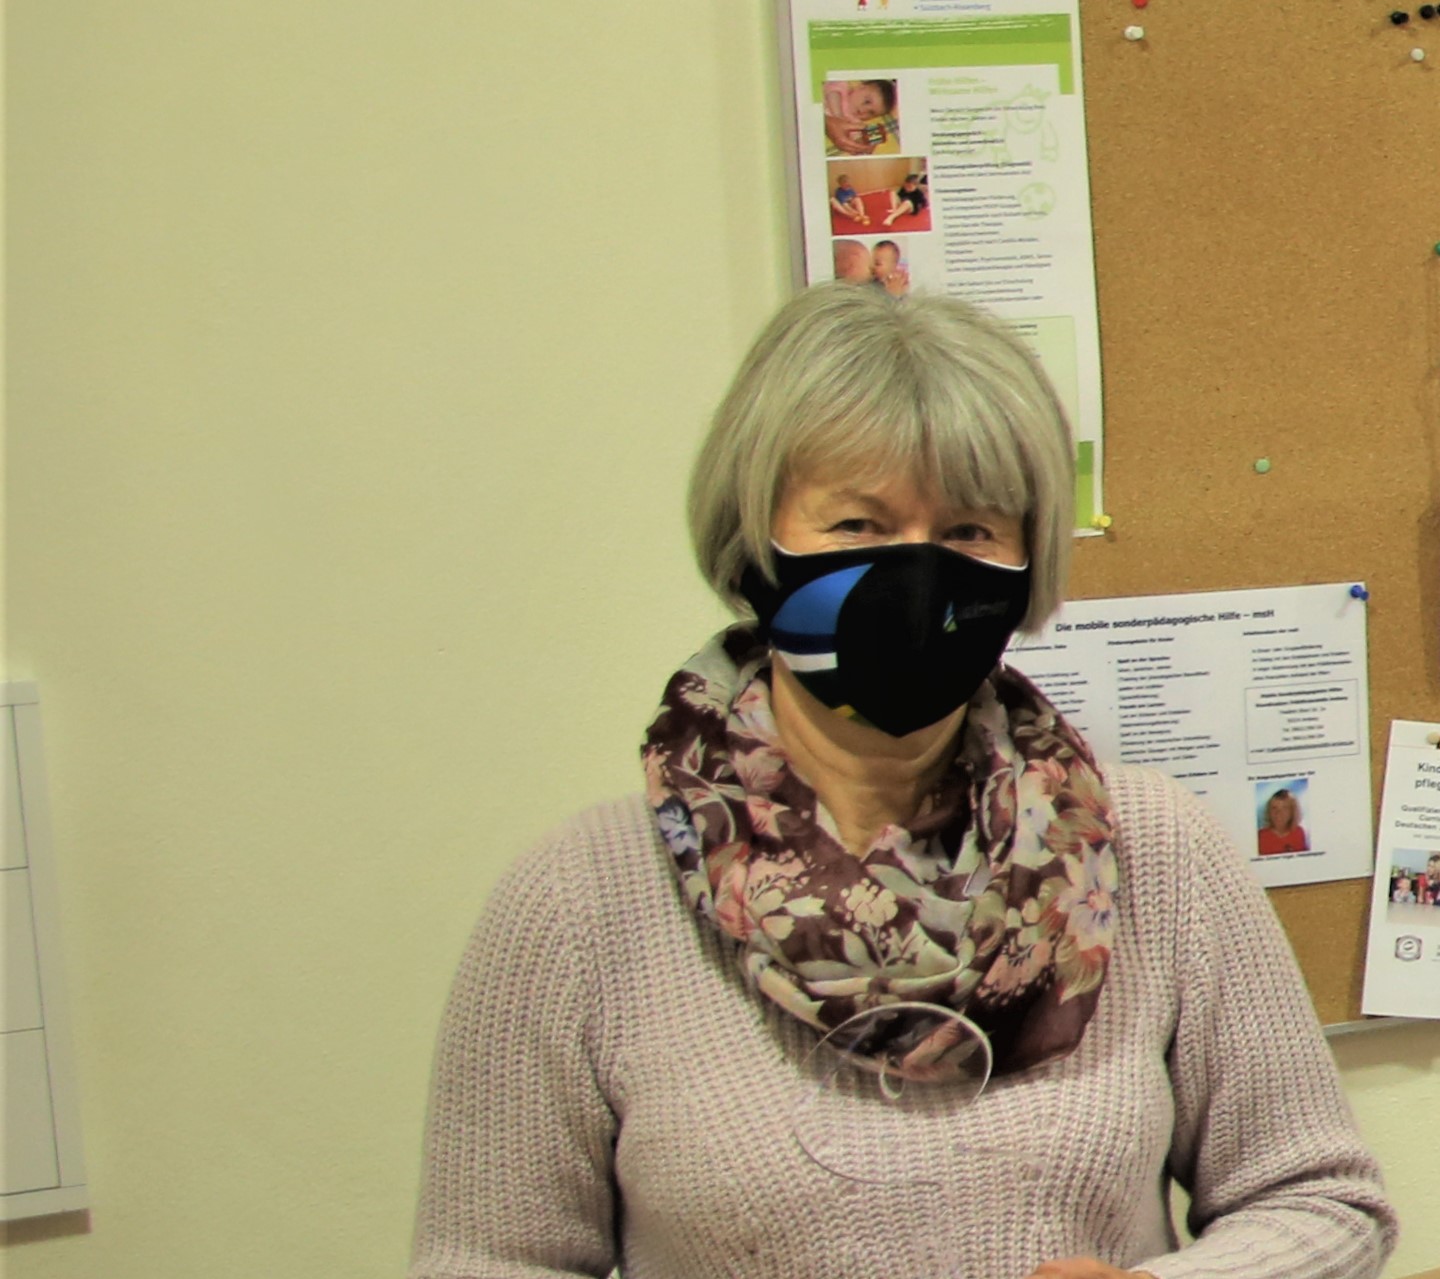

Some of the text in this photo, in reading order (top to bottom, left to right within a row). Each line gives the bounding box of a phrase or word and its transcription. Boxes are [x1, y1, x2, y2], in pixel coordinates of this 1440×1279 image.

[1055, 610, 1274, 632] Die mobile sonderpädagogische Hilfe msH
